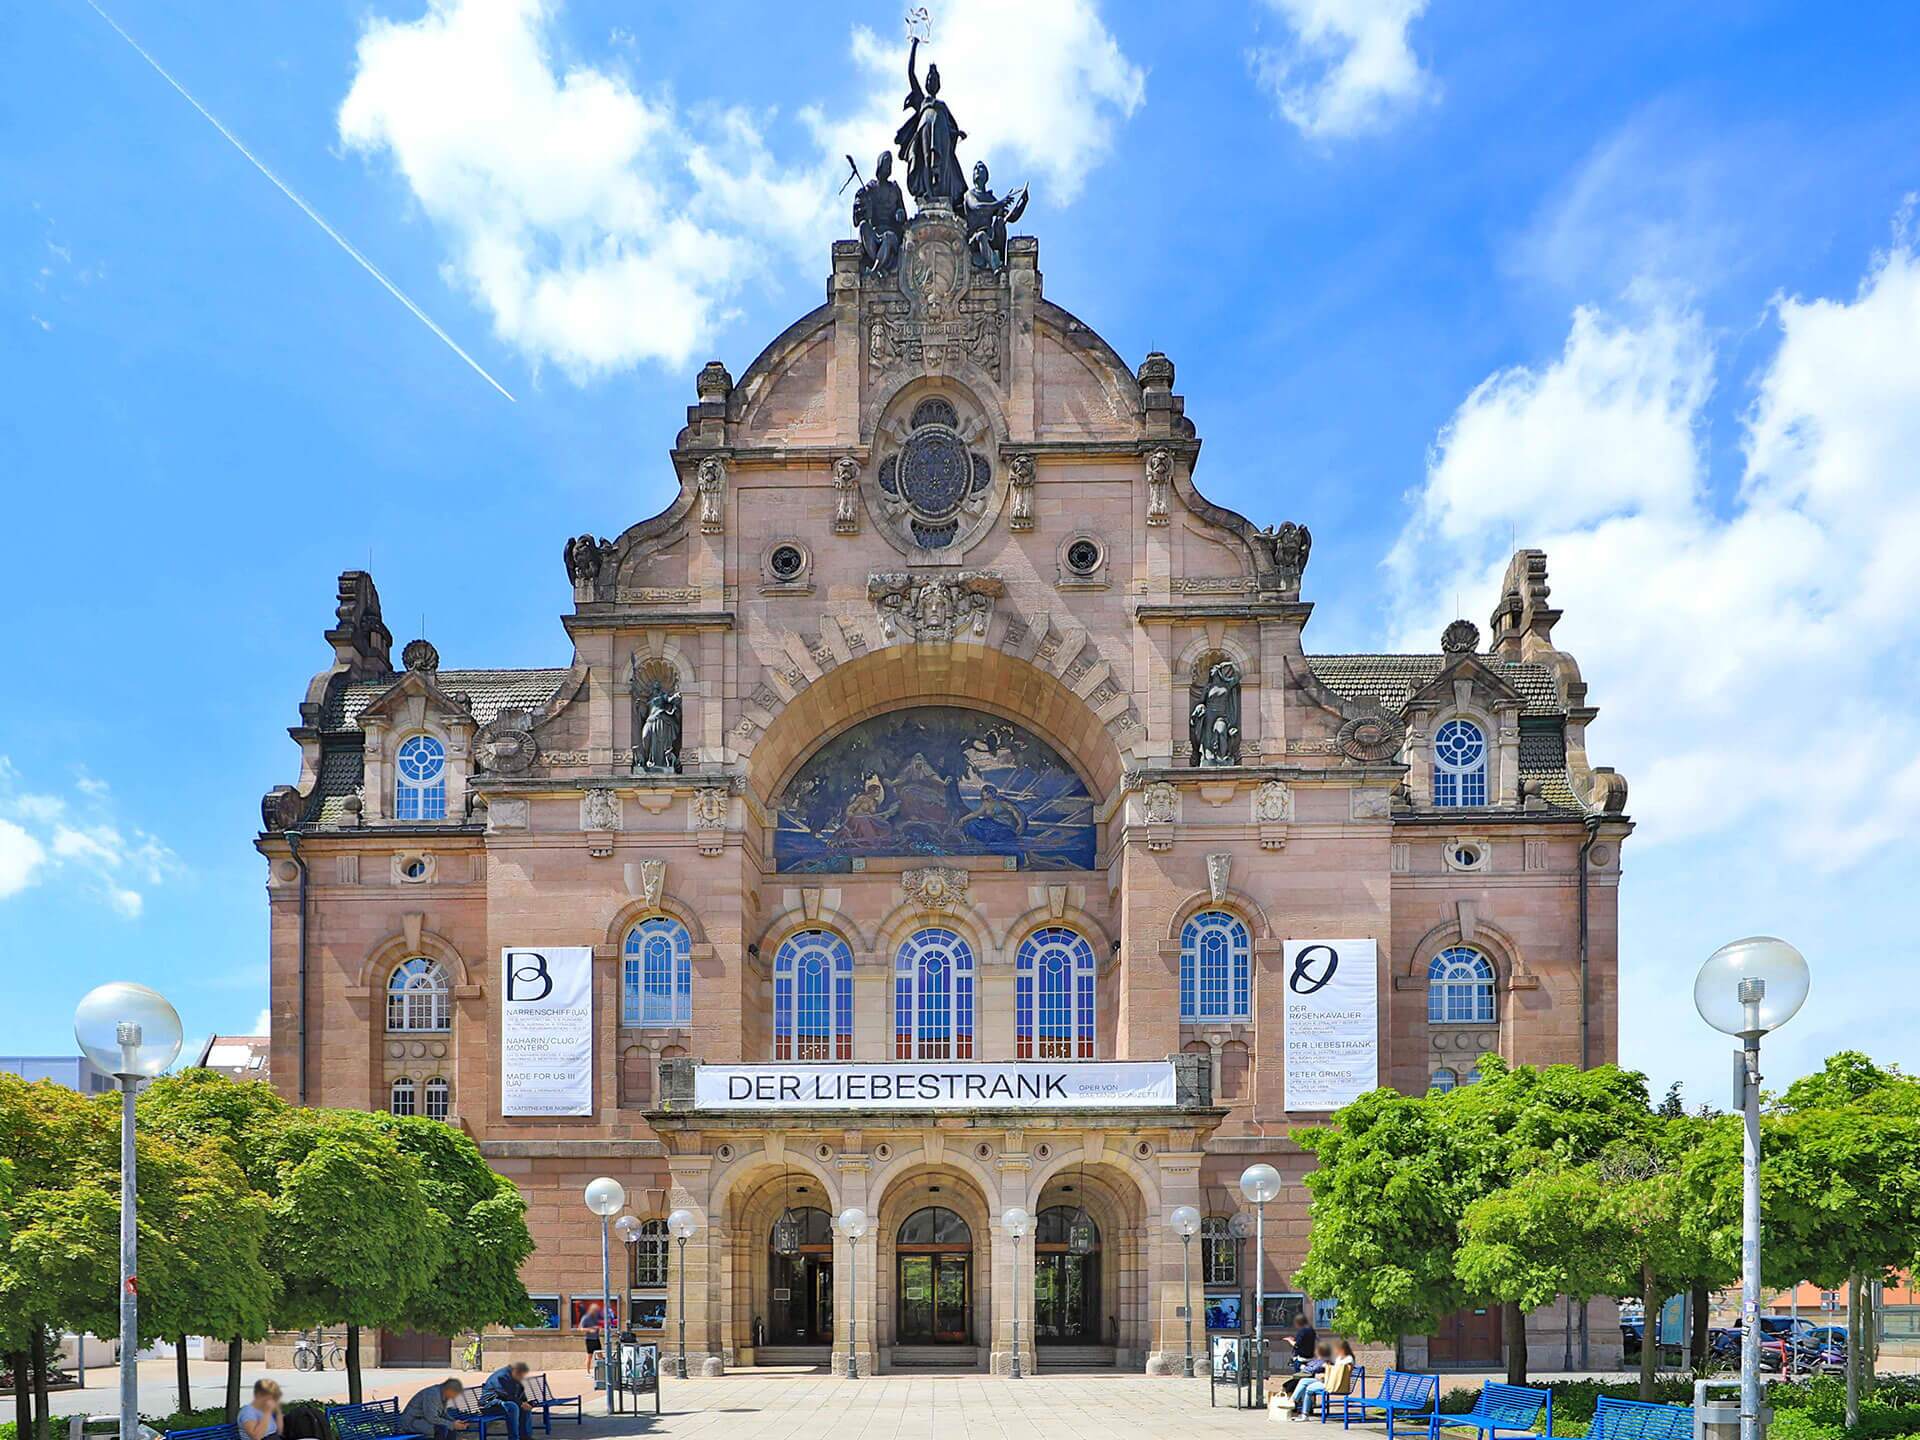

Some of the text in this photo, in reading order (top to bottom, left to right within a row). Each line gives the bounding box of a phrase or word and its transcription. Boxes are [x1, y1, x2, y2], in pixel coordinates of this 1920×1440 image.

[506, 1008, 570, 1016] NARRENSCHIFF
[1289, 1040, 1372, 1049] DER LIEBESTRANK
[1318, 1070, 1352, 1078] GRIMES
[729, 1073, 1068, 1100] DER LIEBESTRANK
